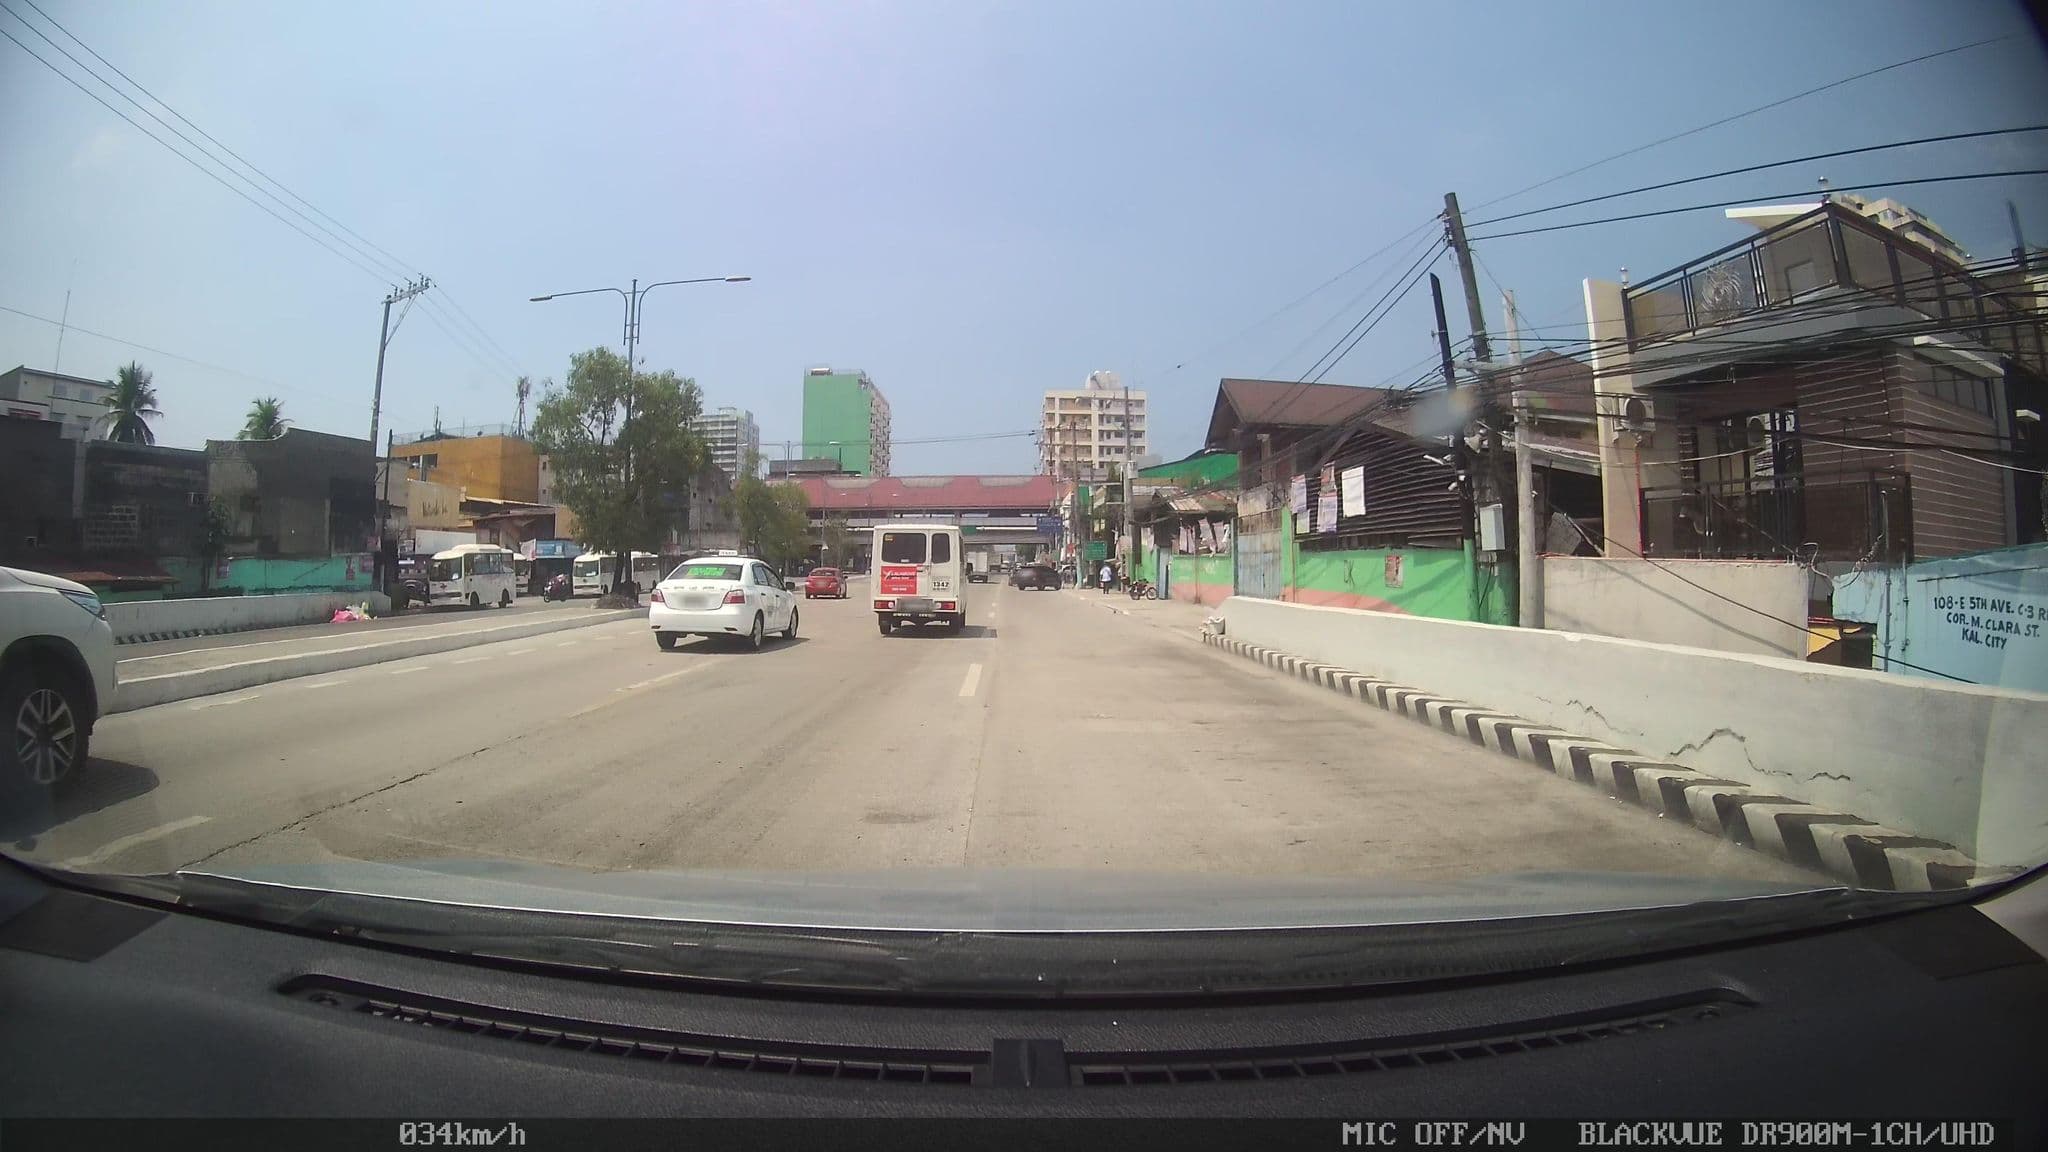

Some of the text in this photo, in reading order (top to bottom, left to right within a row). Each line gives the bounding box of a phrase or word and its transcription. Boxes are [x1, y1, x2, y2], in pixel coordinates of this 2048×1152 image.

[1934, 596, 2048, 621] 108-E 5TH AVE. C-3 R
[1946, 612, 2040, 638] COR. M. CLARA ST.
[1962, 627, 2007, 649] KAL. CITY
